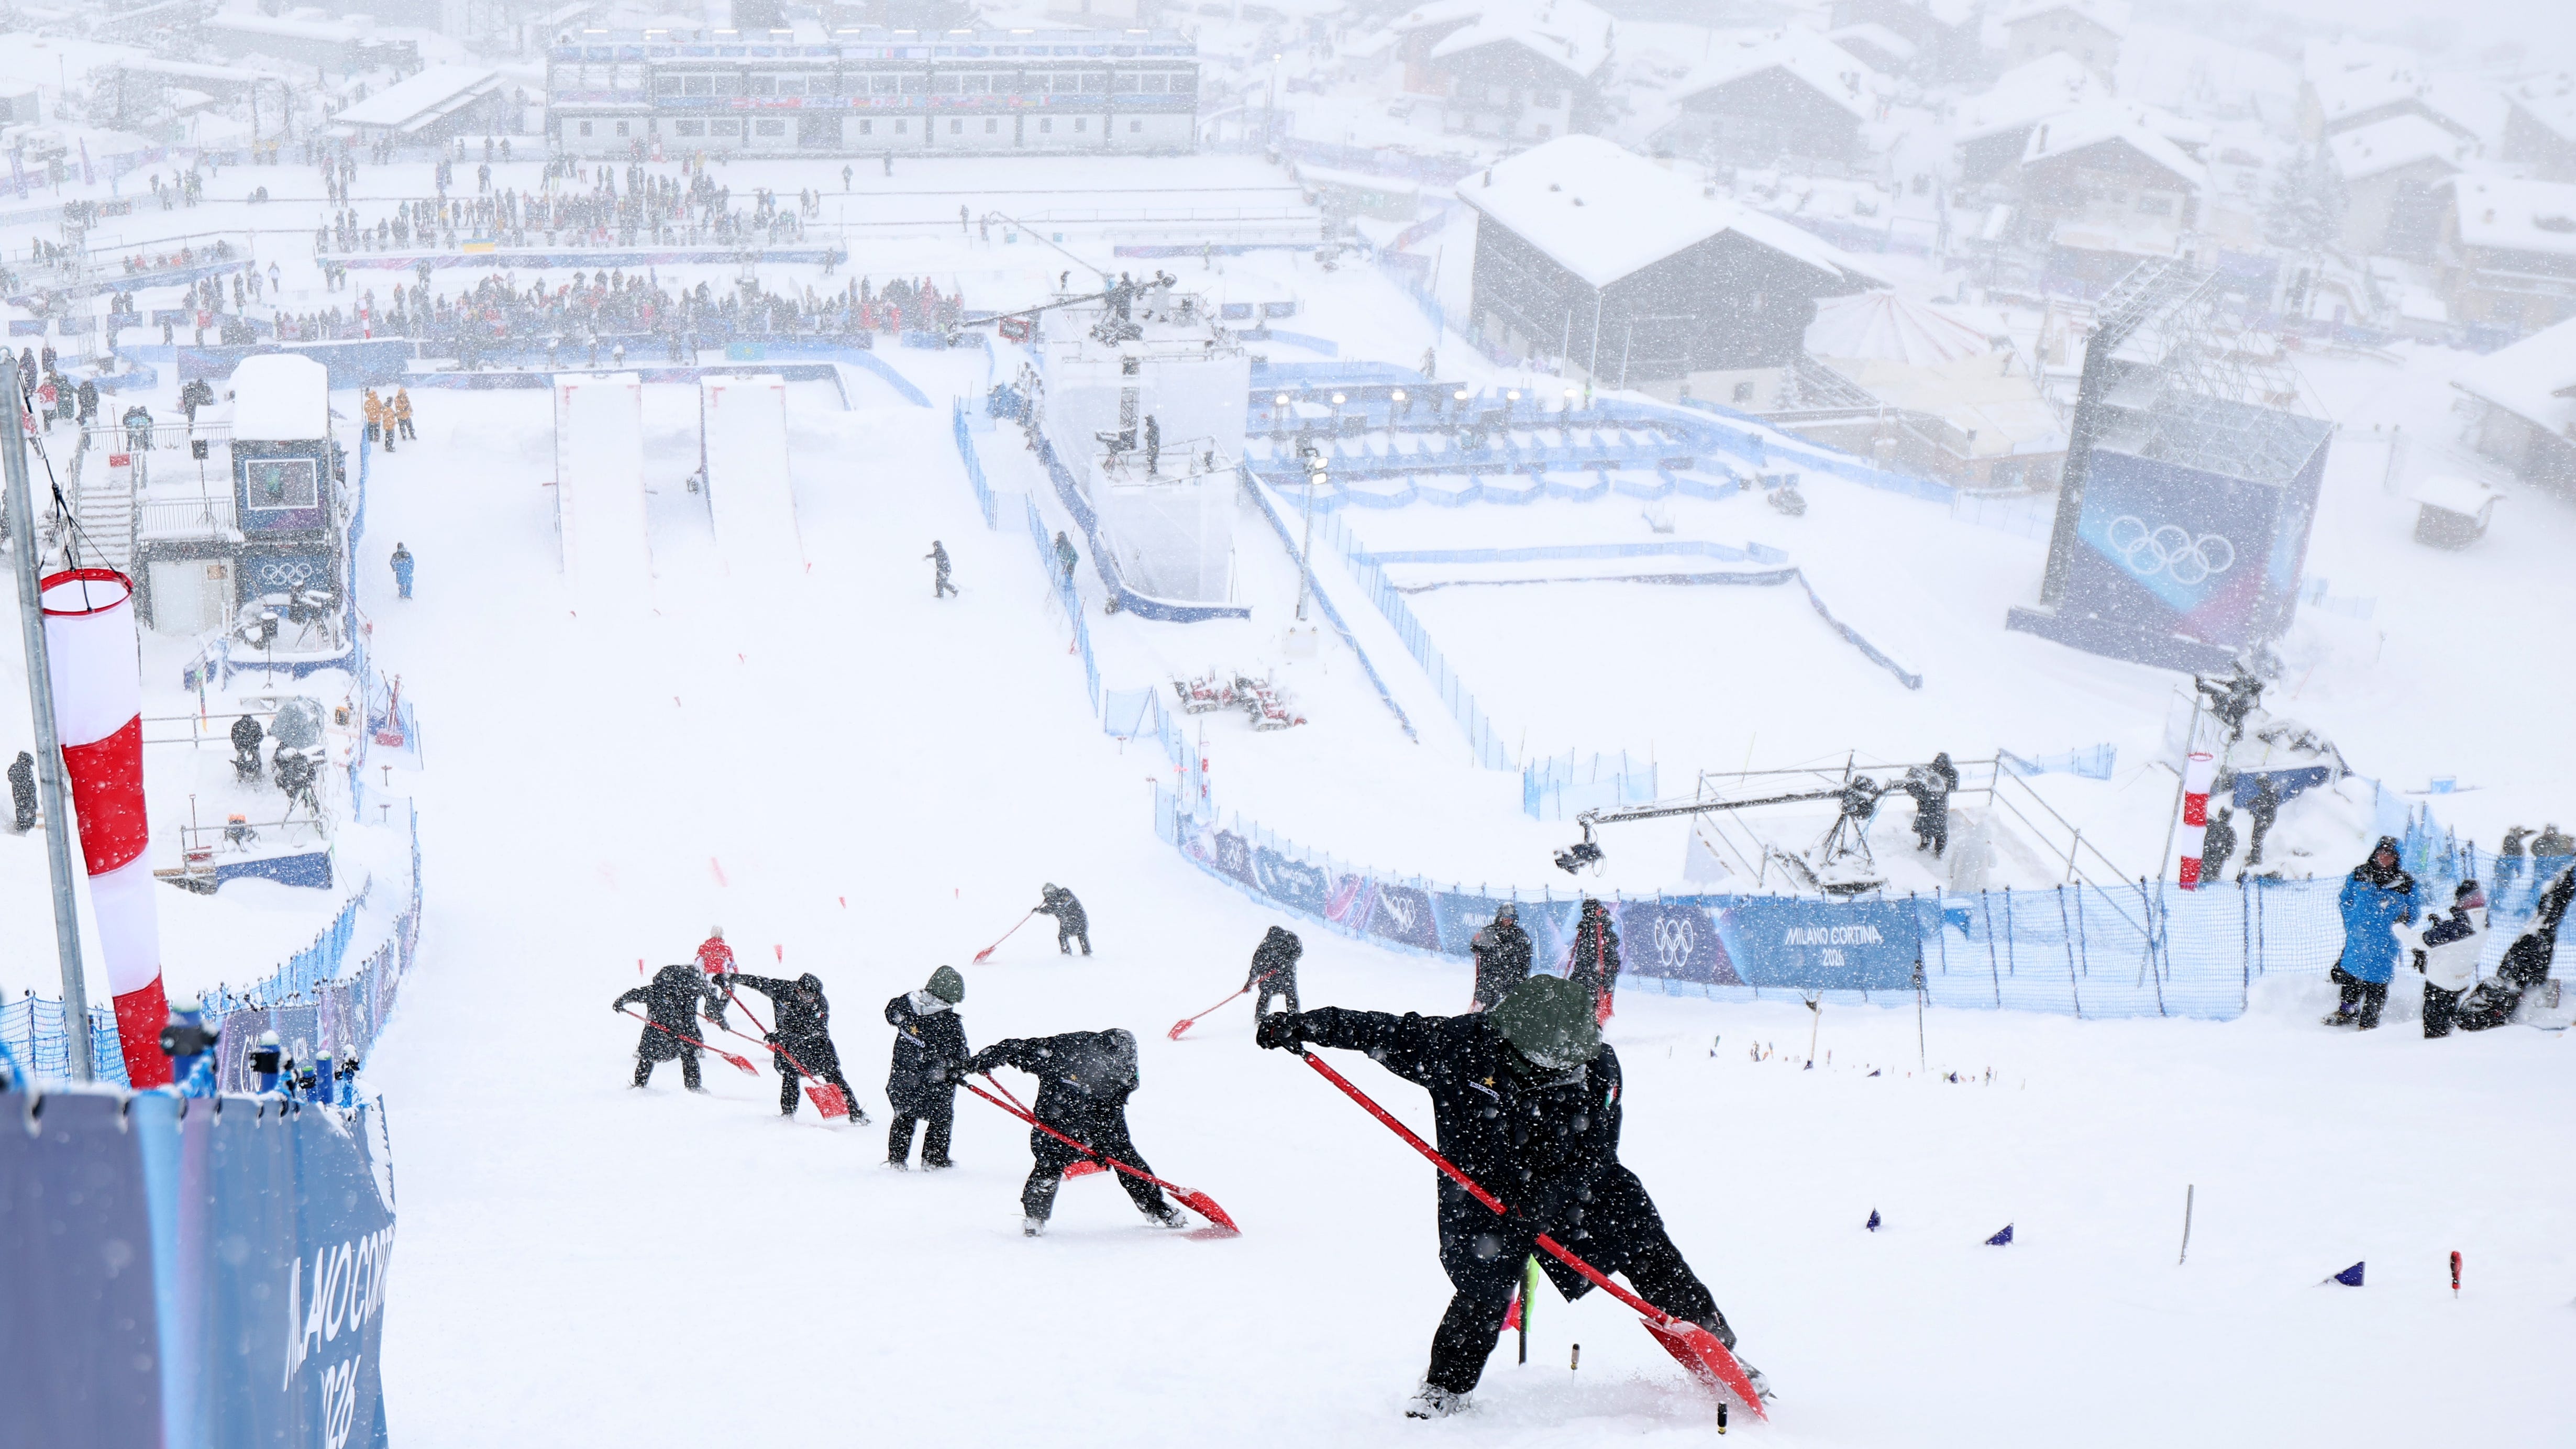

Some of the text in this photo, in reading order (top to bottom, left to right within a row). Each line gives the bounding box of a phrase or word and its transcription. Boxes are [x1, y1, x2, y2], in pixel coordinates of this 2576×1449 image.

[1462, 913, 1487, 927] MILANO
[1785, 925, 1884, 945] MILANO CORTINA
[1822, 948, 1845, 966] 2026
[1469, 1081, 1500, 1100] ESERCITO
